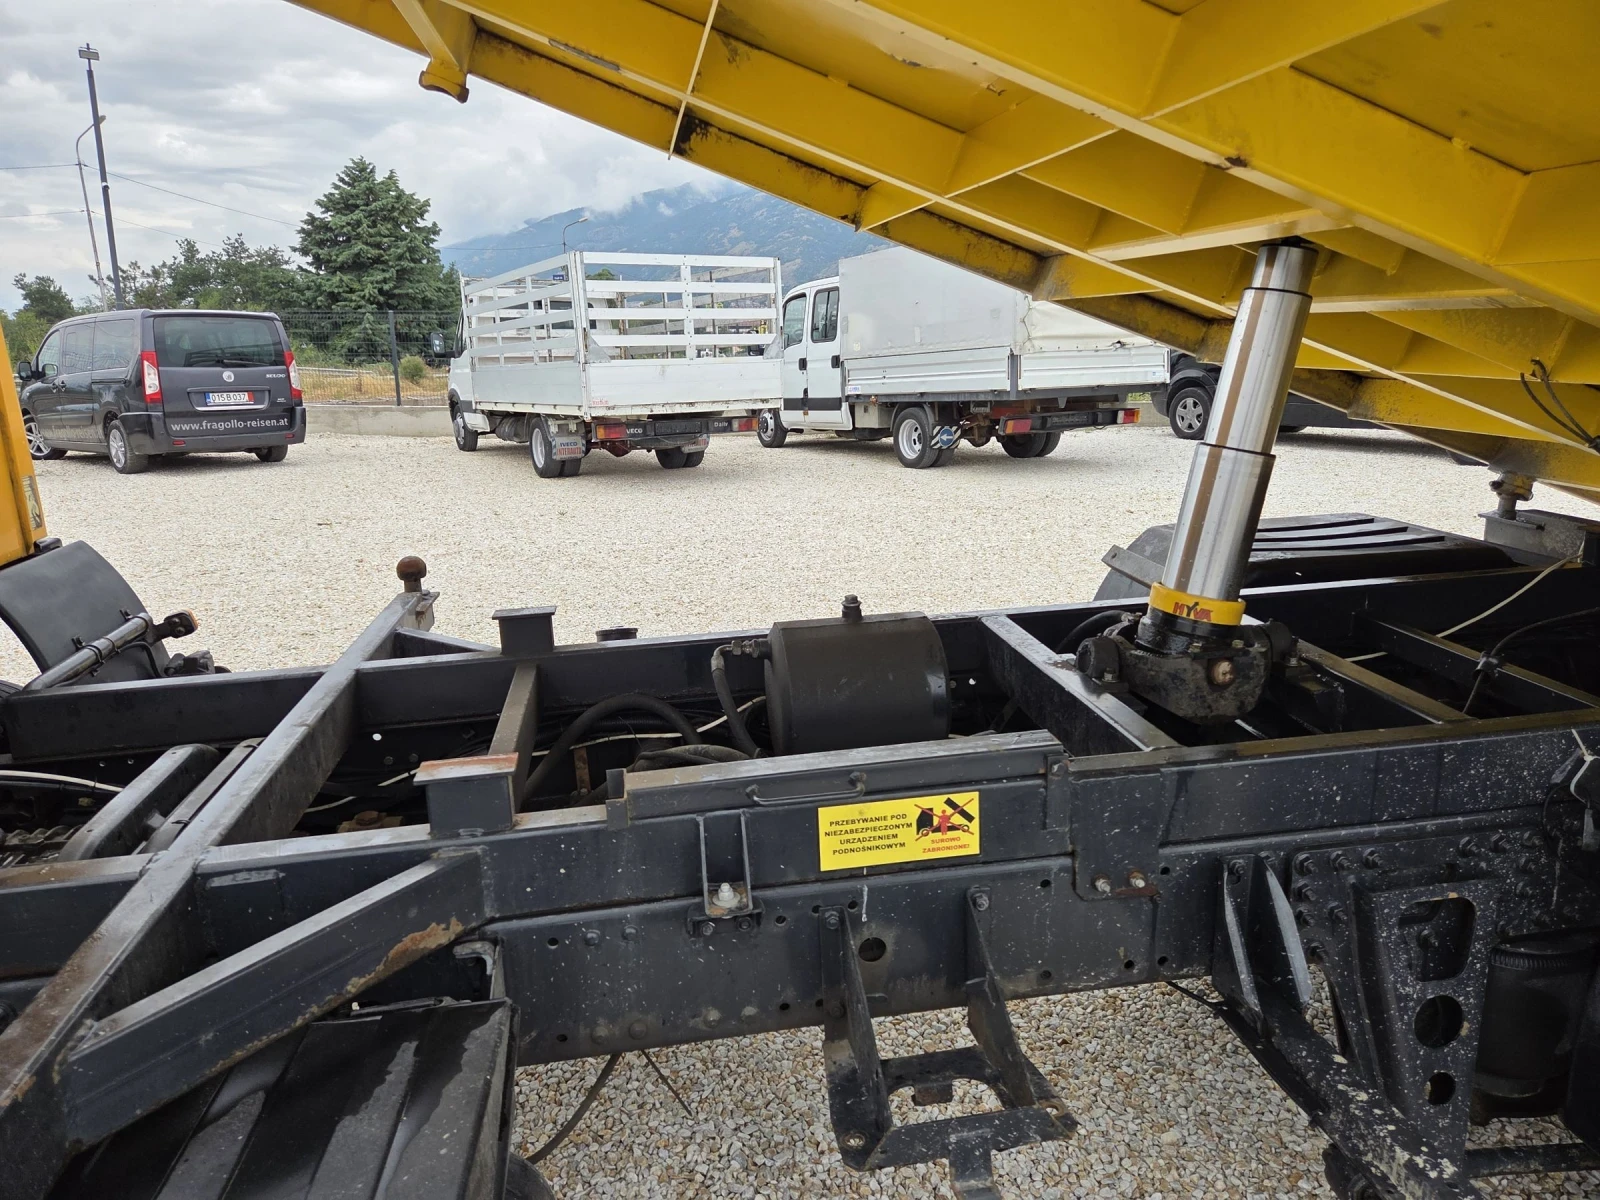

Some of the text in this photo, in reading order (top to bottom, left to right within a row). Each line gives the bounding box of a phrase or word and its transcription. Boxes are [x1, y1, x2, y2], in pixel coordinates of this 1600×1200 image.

[171, 418, 288, 431] www.fragollo-reisen.at
[1173, 602, 1213, 622] HYVA
[830, 813, 907, 827] PRZEBYWANIE POD
[824, 822, 912, 837] NIEZABEZPIECZONYM
[840, 833, 898, 845] URZĄDZENIEM
[931, 836, 961, 844] SUROWO
[832, 842, 906, 856] PODNOŚNIKOWYM
